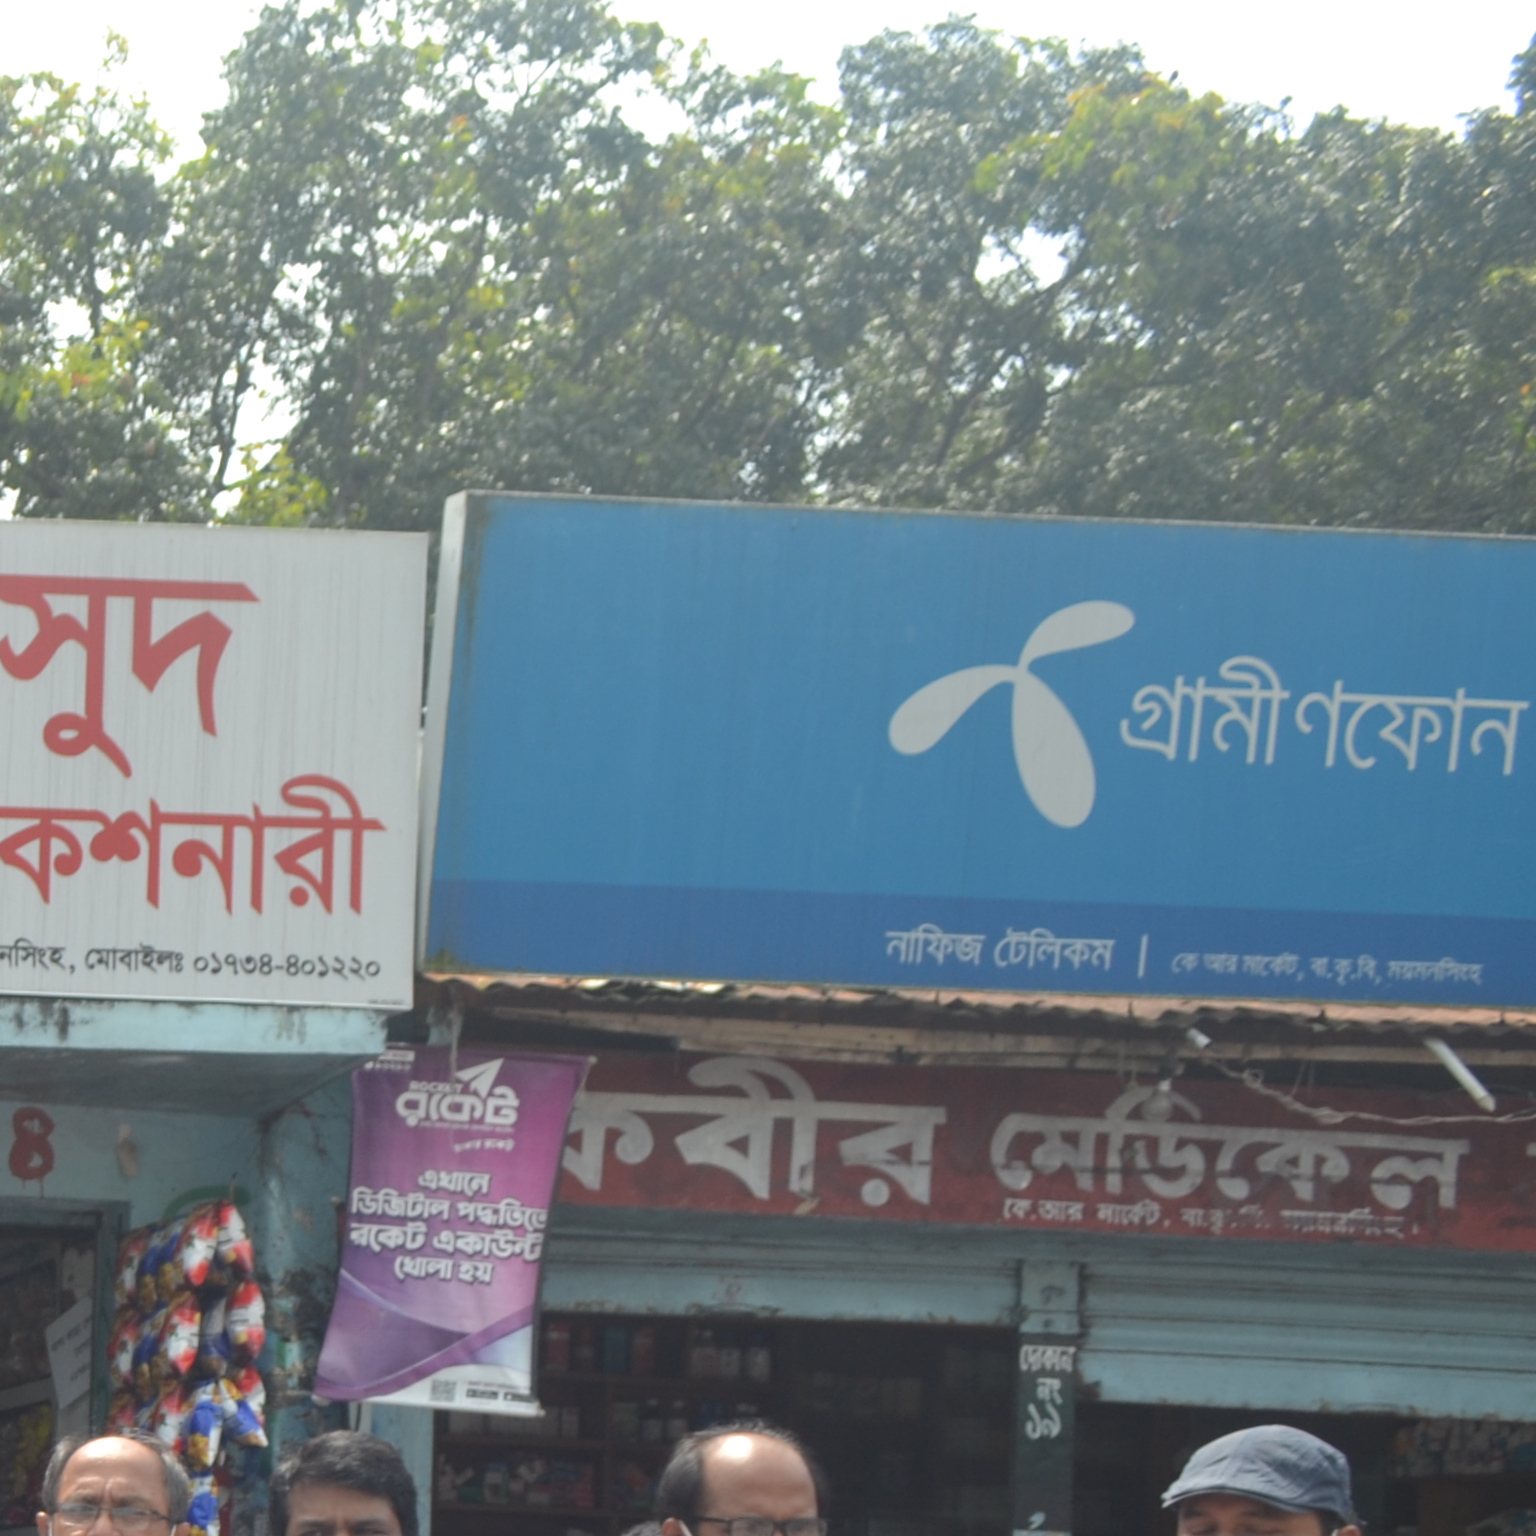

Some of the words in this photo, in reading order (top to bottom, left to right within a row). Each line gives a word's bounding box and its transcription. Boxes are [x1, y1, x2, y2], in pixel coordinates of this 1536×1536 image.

[886, 923, 985, 967] নাফিজ
[993, 927, 1115, 972] টেলিকম
[990, 1085, 1470, 1210] মেডিকেল
[418, 1169, 491, 1196] এখানে
[351, 1187, 451, 1220] ডিজিটাল
[349, 1222, 428, 1252] রকেট
[395, 1256, 453, 1279] খোলা
[458, 1261, 494, 1283] হয়
